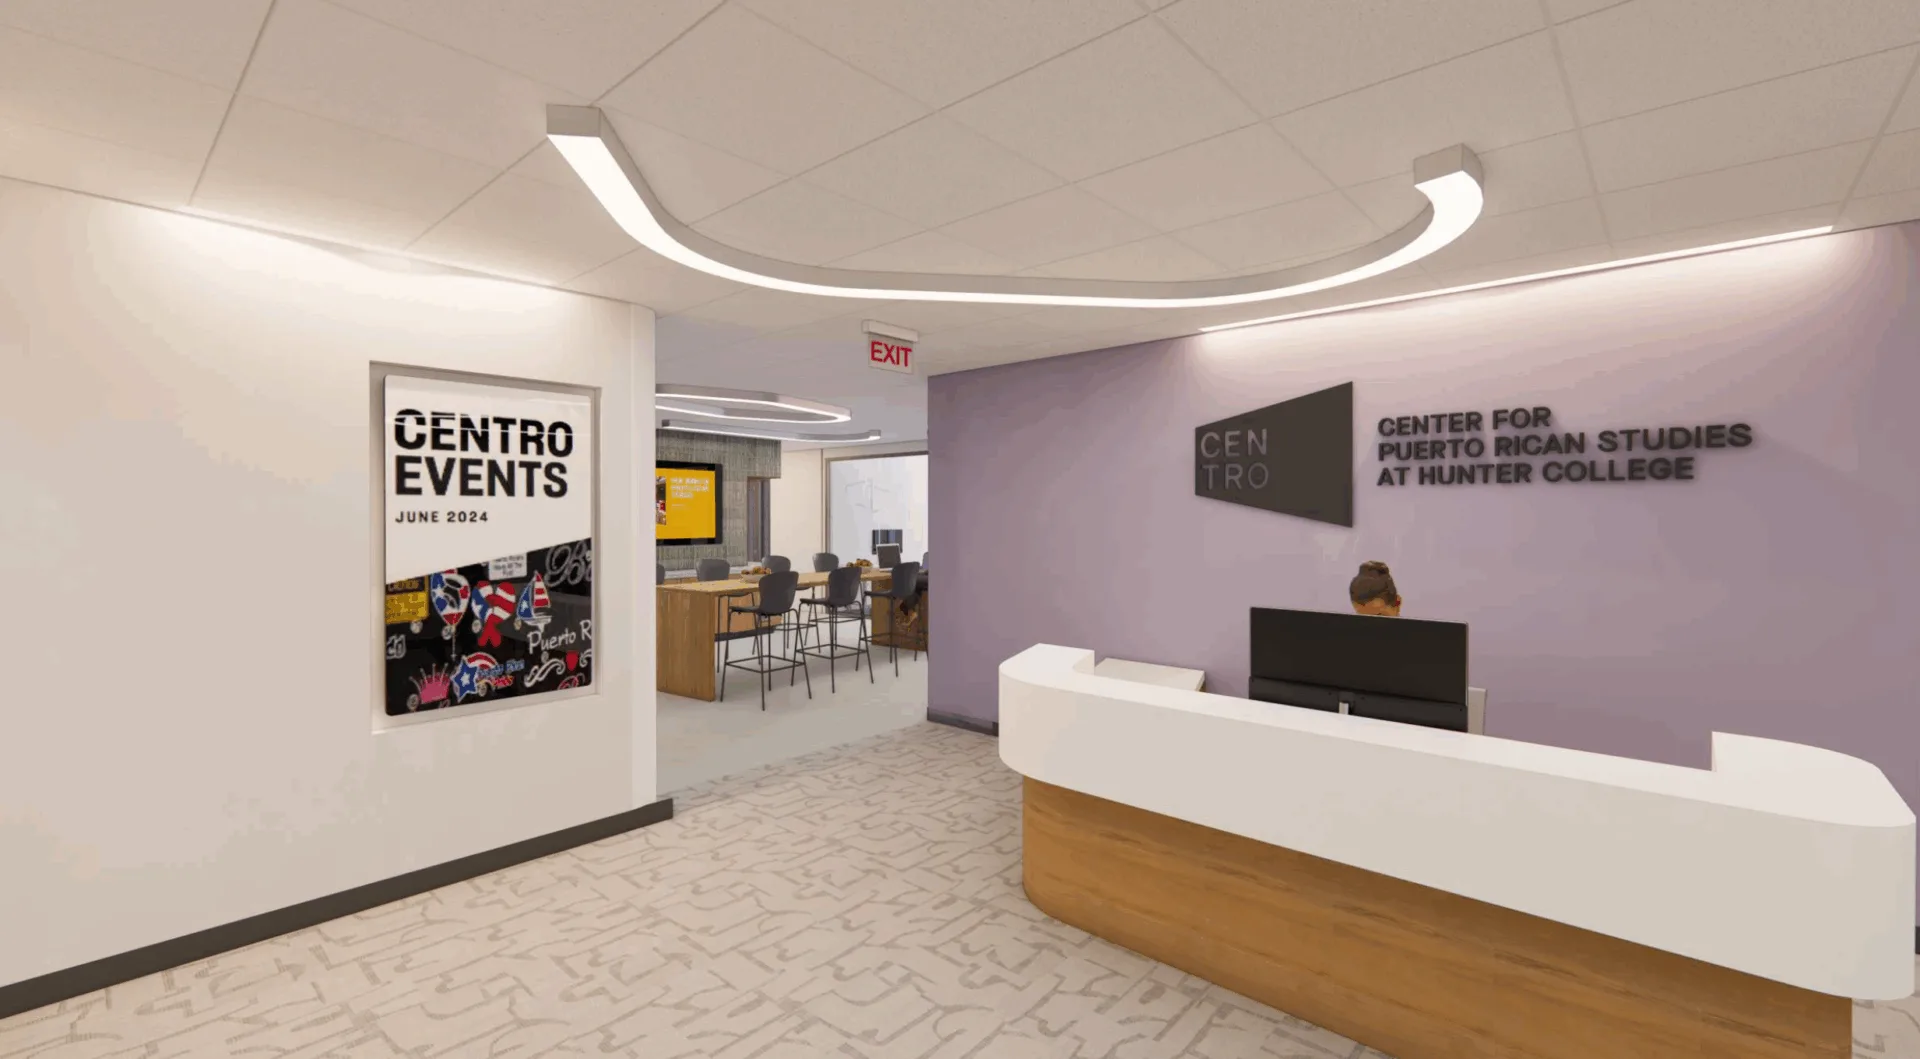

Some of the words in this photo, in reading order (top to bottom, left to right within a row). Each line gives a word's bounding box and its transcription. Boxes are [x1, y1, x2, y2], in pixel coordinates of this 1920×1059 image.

[870, 340, 912, 367] EXIT
[394, 409, 573, 458] CENTRO
[1378, 411, 1482, 436] CENTER
[1492, 407, 1551, 430] FOR
[1200, 428, 1268, 459] CEN
[1378, 437, 1485, 461] PUERTO
[1494, 432, 1585, 456] RICAN
[1597, 423, 1753, 453] STUDIES
[395, 455, 568, 498] EVENTS
[1201, 462, 1269, 490] TRO
[1376, 467, 1410, 486] AT
[1418, 462, 1533, 485] HUNTER
[1542, 456, 1695, 483] COLLEGE
[395, 511, 439, 523] JUNE
[447, 511, 488, 523] 2024
[527, 627, 577, 655] Puerto
